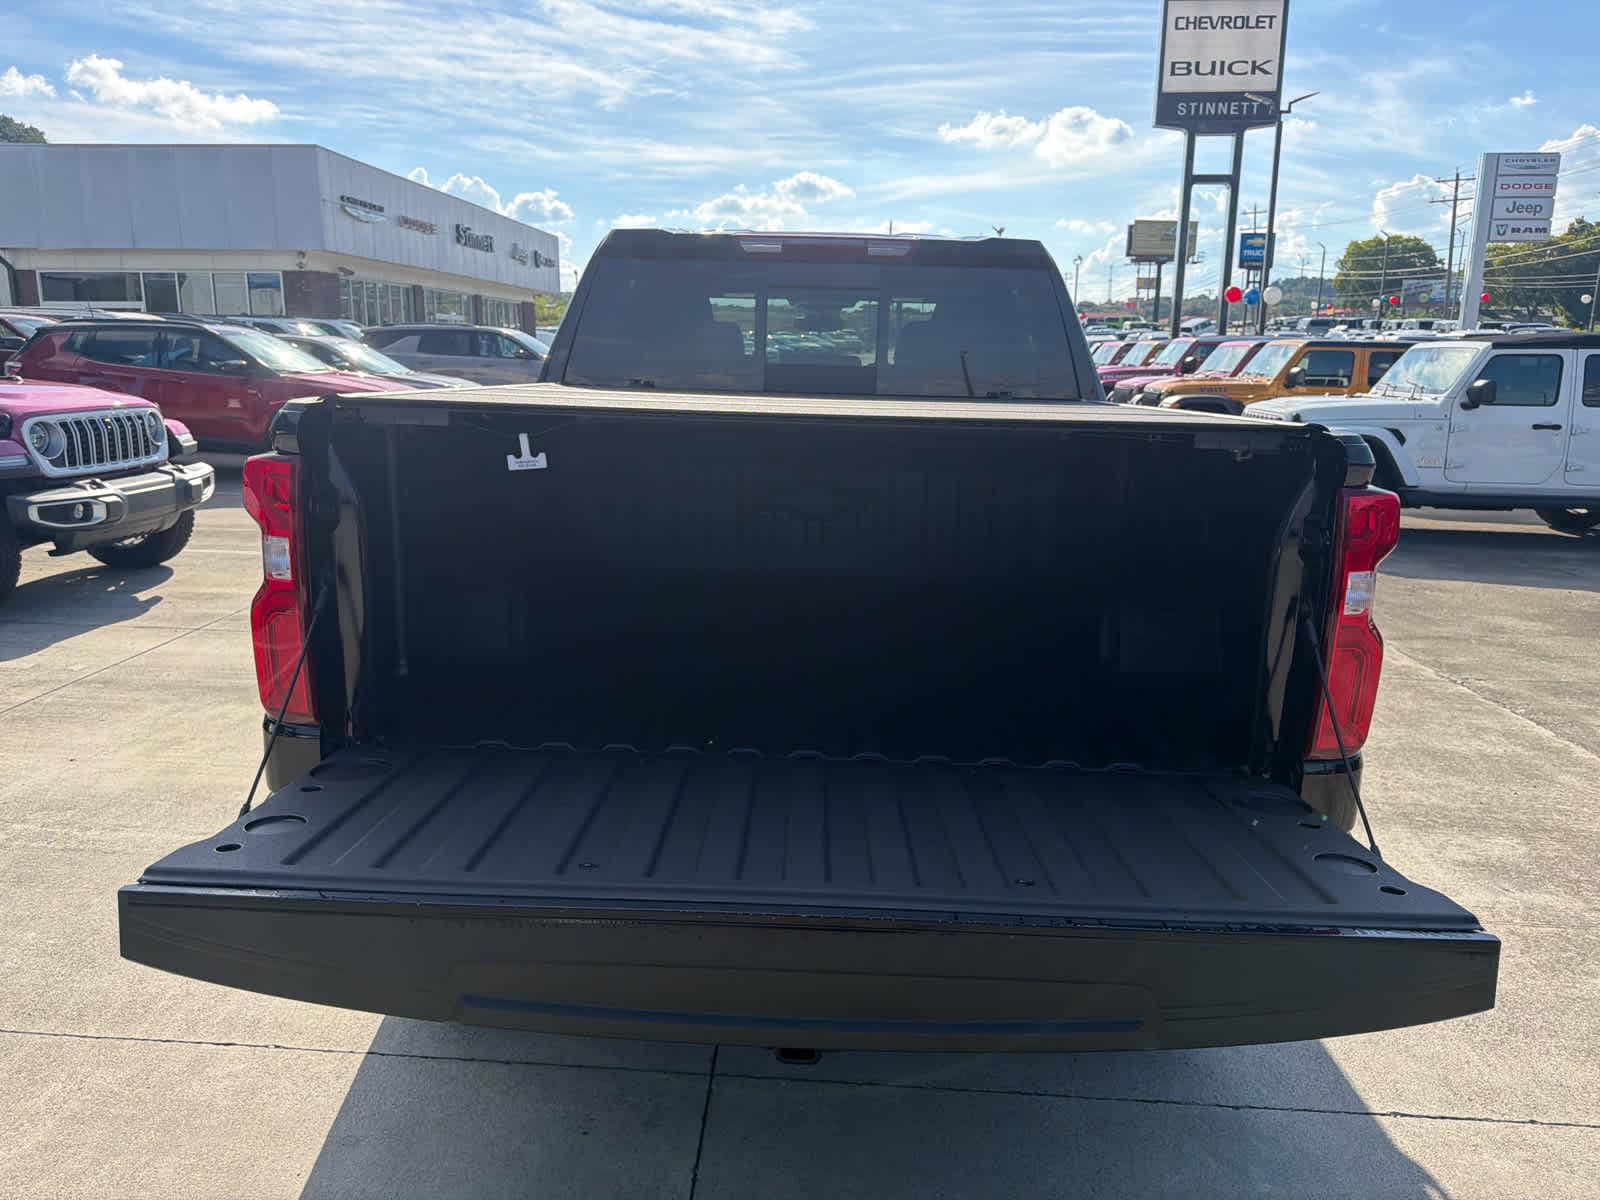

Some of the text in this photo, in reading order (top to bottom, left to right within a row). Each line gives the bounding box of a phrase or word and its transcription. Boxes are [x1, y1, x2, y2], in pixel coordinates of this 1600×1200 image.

[1174, 15, 1277, 30] CHEVROLET
[1170, 60, 1272, 76] BUICK
[1177, 102, 1259, 116] STINNETT
[1505, 201, 1543, 216] Jeep
